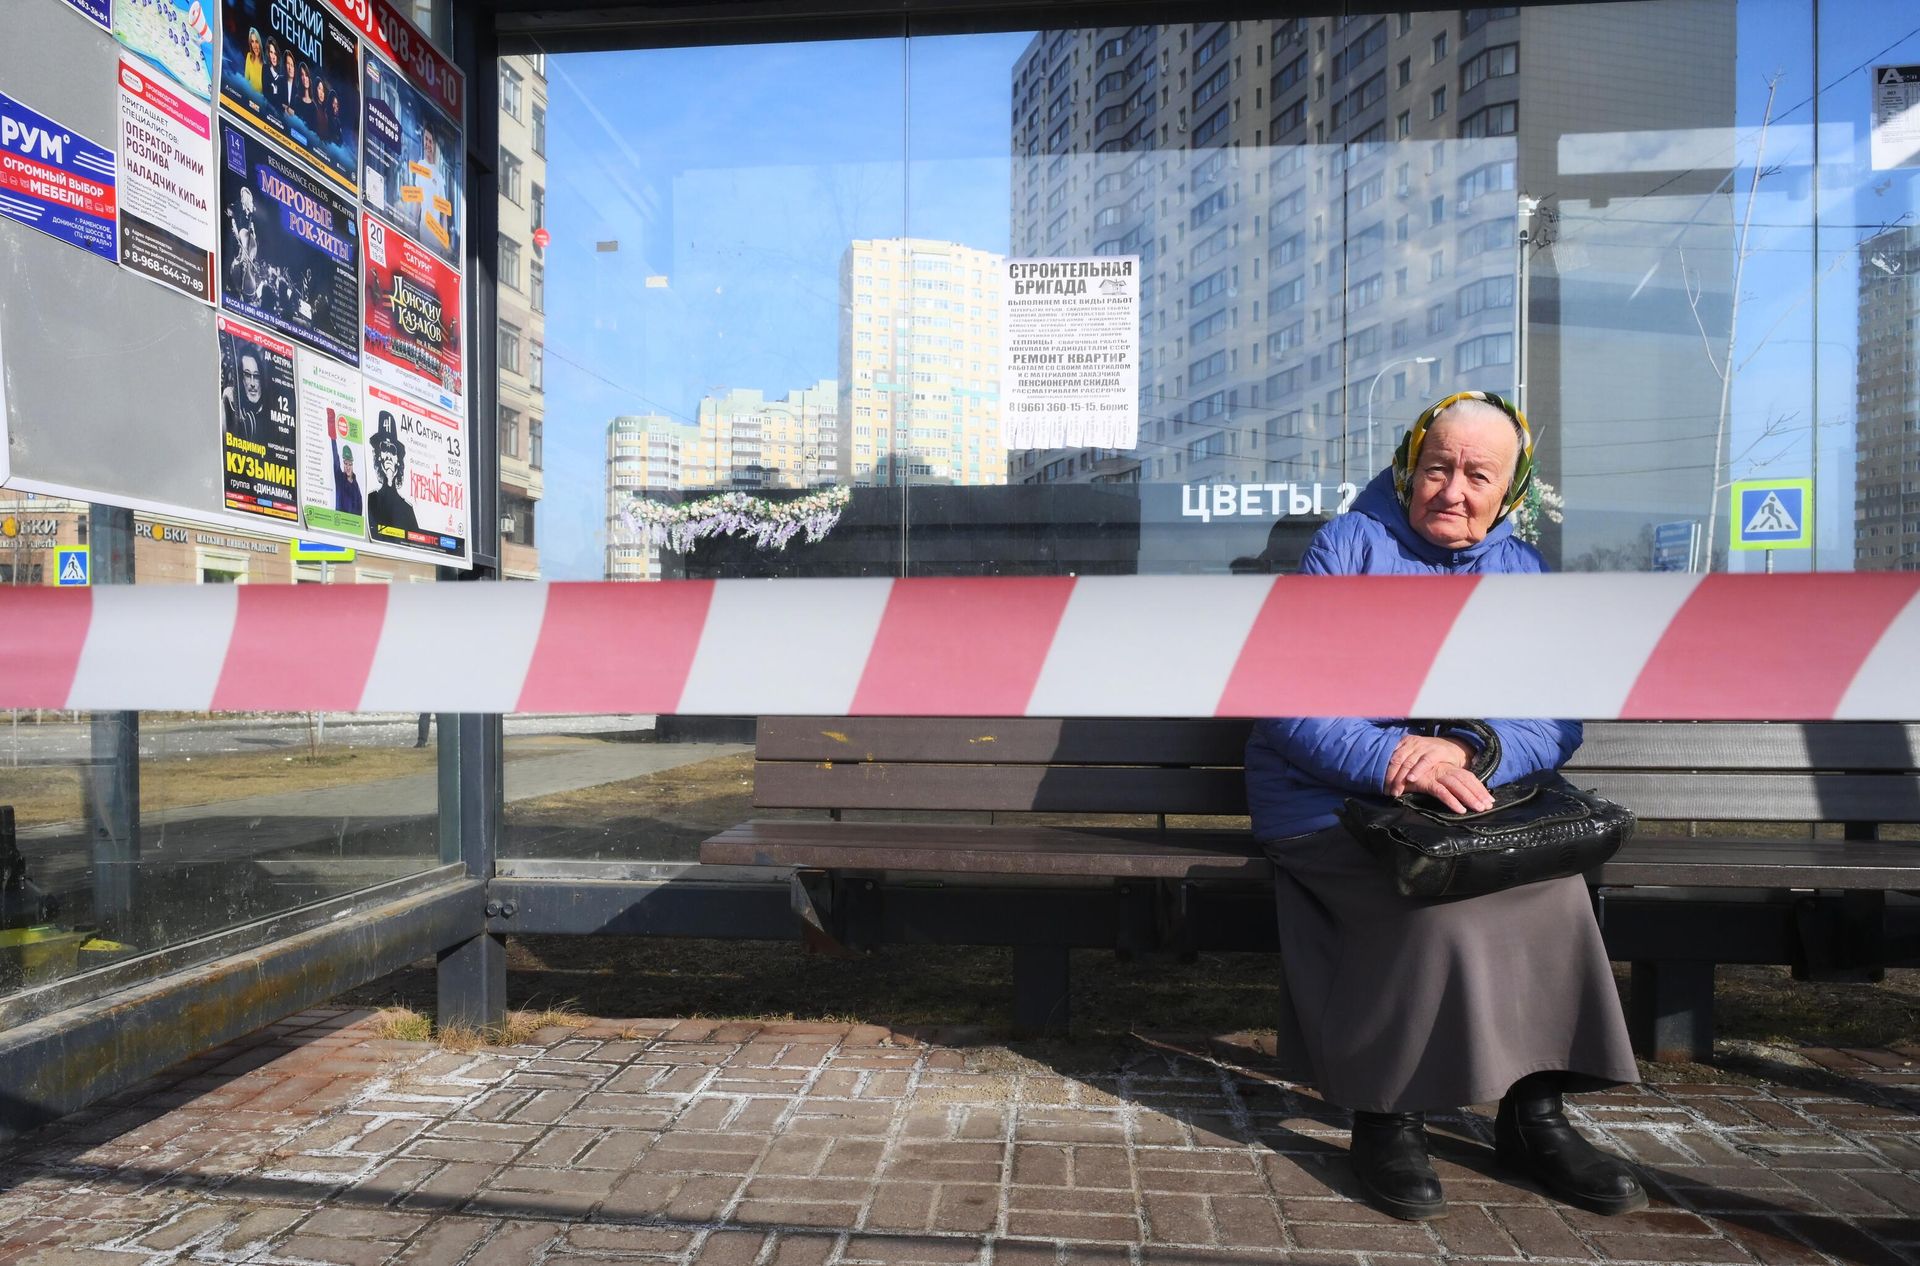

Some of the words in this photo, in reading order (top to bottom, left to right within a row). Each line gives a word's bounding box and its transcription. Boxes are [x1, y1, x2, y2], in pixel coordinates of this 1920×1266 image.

[271, 3, 323, 67] СТЕНДАП
[378, 6, 457, 106] 308-30-10
[121, 94, 169, 127] ПРИГЛАШАЕТ
[121, 105, 180, 144] СПЕЦИАЛИСТОВ:
[368, 103, 399, 132] ЗАРАБАТЫВАЙ
[126, 121, 173, 156] ОПЕРАТОР
[174, 149, 205, 177] ЛИНИИ
[127, 136, 170, 171] РОЗЛИВА
[231, 134, 240, 150] 14
[3, 156, 67, 187] ОГРОМНЫЙ
[68, 178, 105, 198] ВЫБОР
[127, 158, 177, 196] НАЛАДЧИК
[178, 186, 208, 212] КИПиА
[267, 155, 309, 189] RENAISSANCE
[308, 179, 329, 202] CELLOS
[30, 179, 84, 208] МЕБЕЛИ
[260, 169, 334, 232] МИРОВЫЕ
[289, 211, 350, 262] РОК-ХИТЫ
[370, 223, 383, 245] 20
[132, 251, 204, 292] 8-968-644-37-89
[1009, 261, 1132, 279] СТРОИТЕЛЬНАЯ
[1014, 279, 1087, 296] БРИГАДА
[398, 306, 442, 342] КАЗАКОВ
[253, 334, 292, 357] art-concert.ru
[1013, 354, 1064, 364] РЕМОНТ
[1067, 352, 1127, 364] КВАРТИР
[1018, 379, 1082, 387] ПЕНСИОНЕРАМ
[1083, 379, 1120, 387] СКИДКА
[278, 395, 289, 412] 12
[1009, 402, 1015, 412] 8
[1017, 402, 1044, 412] (966)
[1100, 402, 1129, 412] Борис
[270, 410, 296, 428] МАРТА
[401, 413, 413, 434] ДК
[226, 432, 266, 458] Владимир
[447, 436, 461, 457] 13
[226, 451, 296, 487] КУЗЬМИН
[230, 479, 251, 490] группа
[253, 483, 293, 501] «ДИНАМИК»
[1182, 482, 1322, 523] ЦВЕТЫ
[196, 533, 225, 546] МАГАЗИН
[226, 537, 250, 550] ПИВНЫХ
[250, 542, 278, 553] РАДОСТЕЙ
